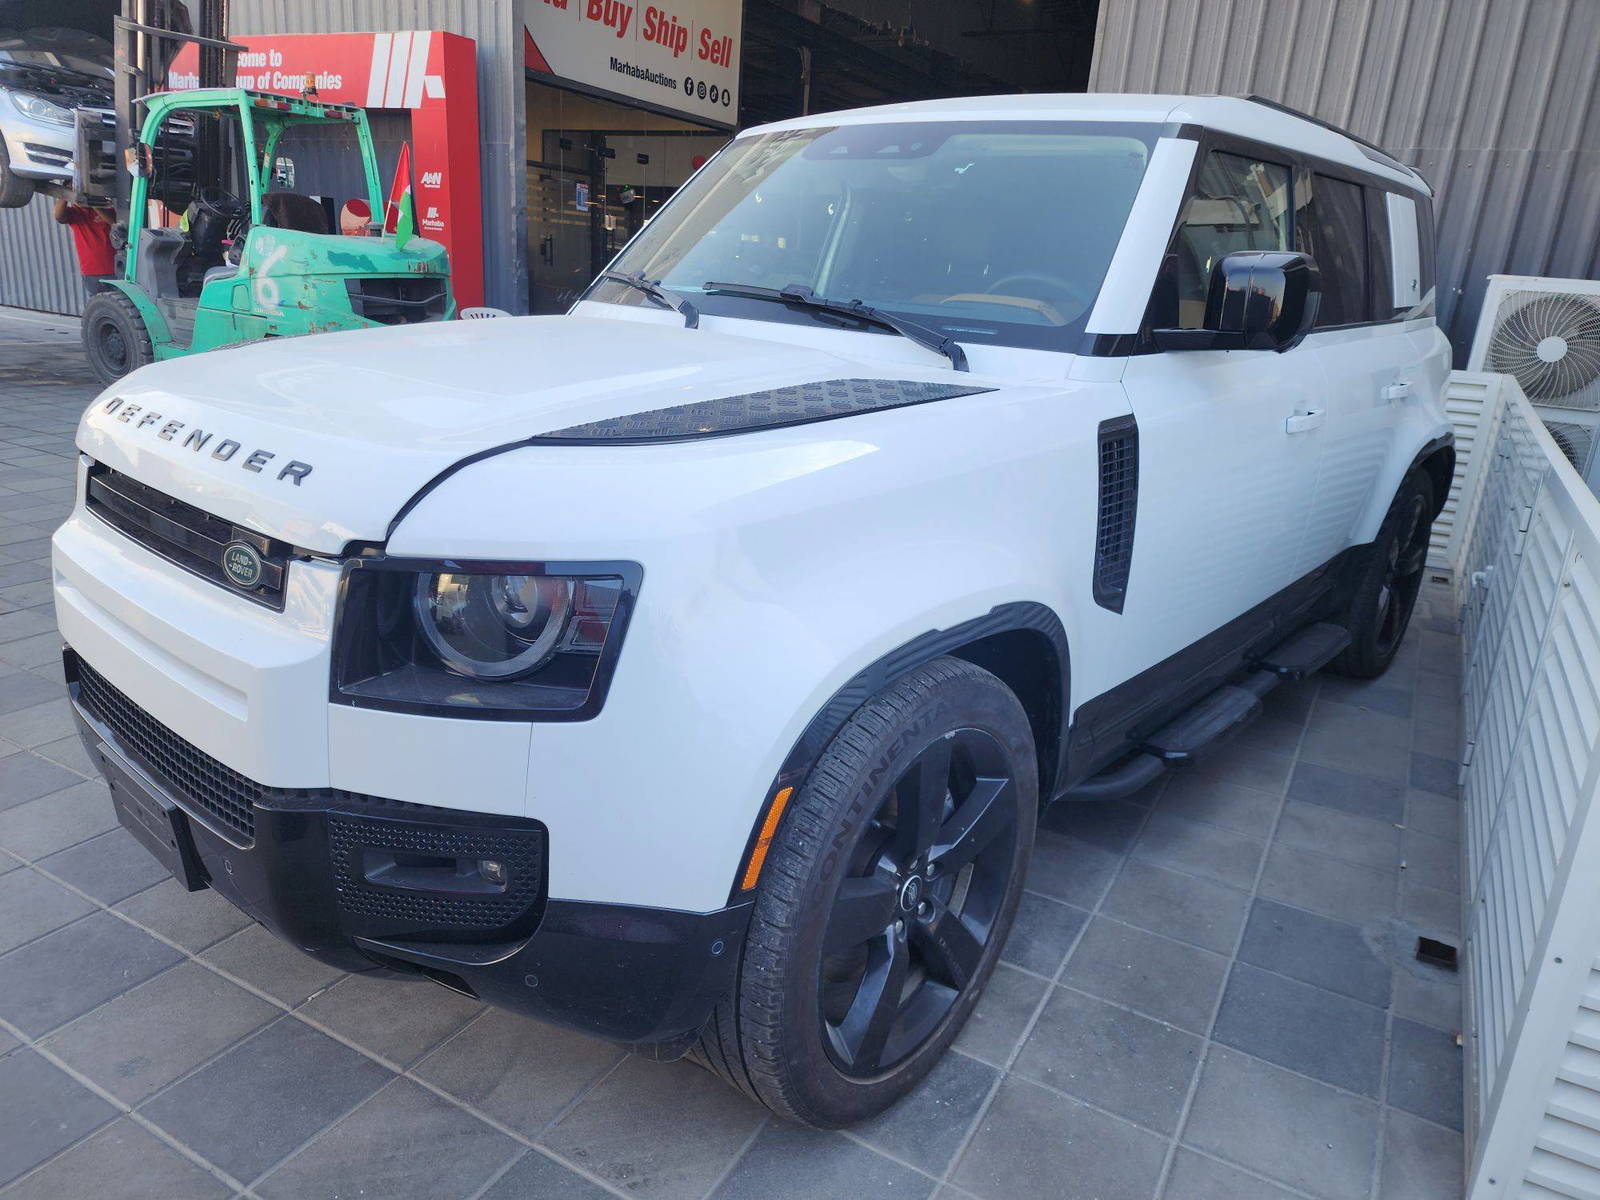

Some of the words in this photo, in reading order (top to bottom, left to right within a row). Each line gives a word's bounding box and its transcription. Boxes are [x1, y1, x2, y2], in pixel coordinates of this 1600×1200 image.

[642, 6, 688, 58] Ship
[698, 27, 733, 68] Sell
[269, 48, 283, 68] to
[610, 56, 677, 89] MarhabaAuctions
[257, 70, 271, 90] of
[273, 70, 342, 93] Compnies
[103, 396, 314, 487] DEFENDER
